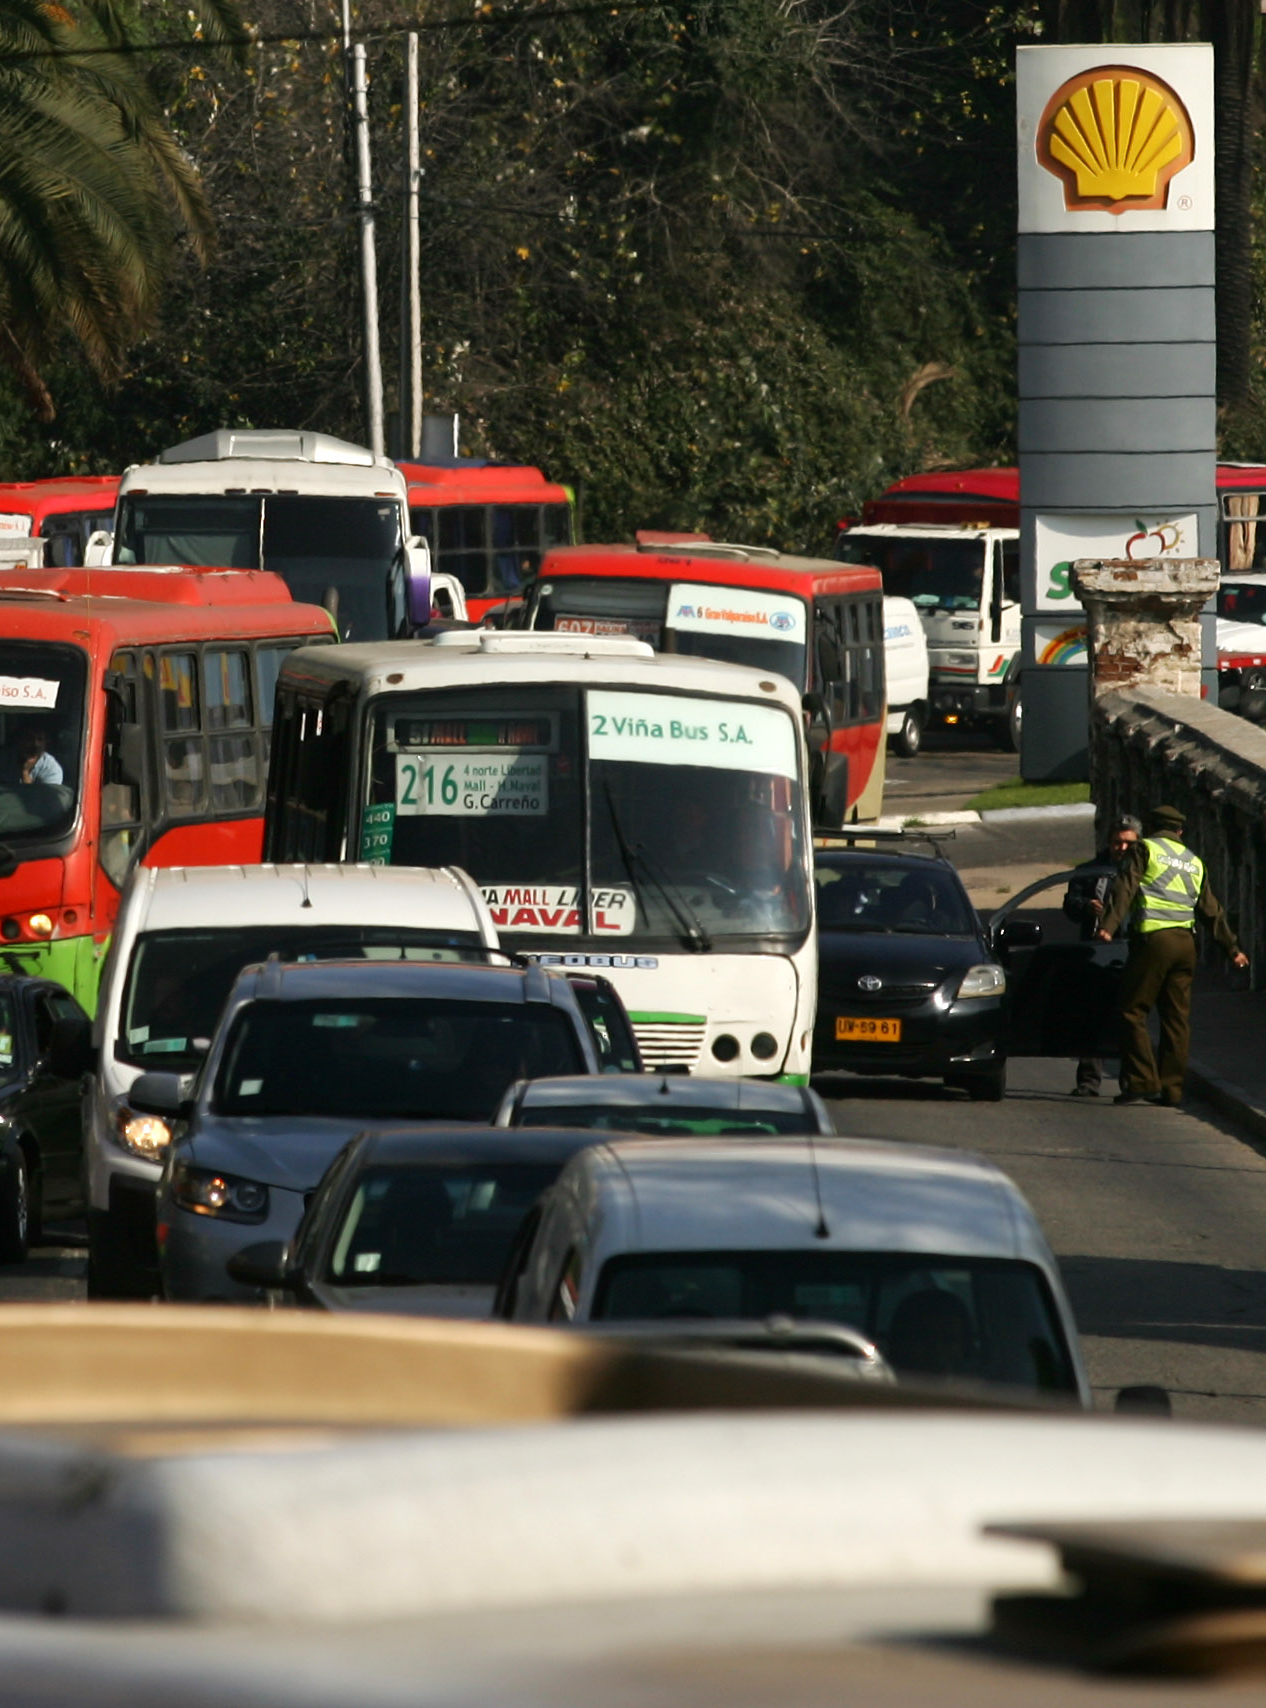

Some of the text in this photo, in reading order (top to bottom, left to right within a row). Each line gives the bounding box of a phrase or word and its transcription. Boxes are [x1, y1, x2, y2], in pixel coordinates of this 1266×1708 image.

[558, 619, 593, 633] 607
[23, 685, 48, 700] S.A.
[592, 715, 753, 744] 2 Viña Bus S.A.
[472, 766, 497, 776] norte
[501, 764, 542, 777] Libertad
[401, 764, 458, 806] 216
[464, 780, 486, 792] Mall
[365, 811, 390, 825] 440
[364, 834, 388, 849] 370
[503, 889, 550, 905] MALL
[557, 890, 626, 909] LIER
[490, 908, 621, 930] NAVAL
